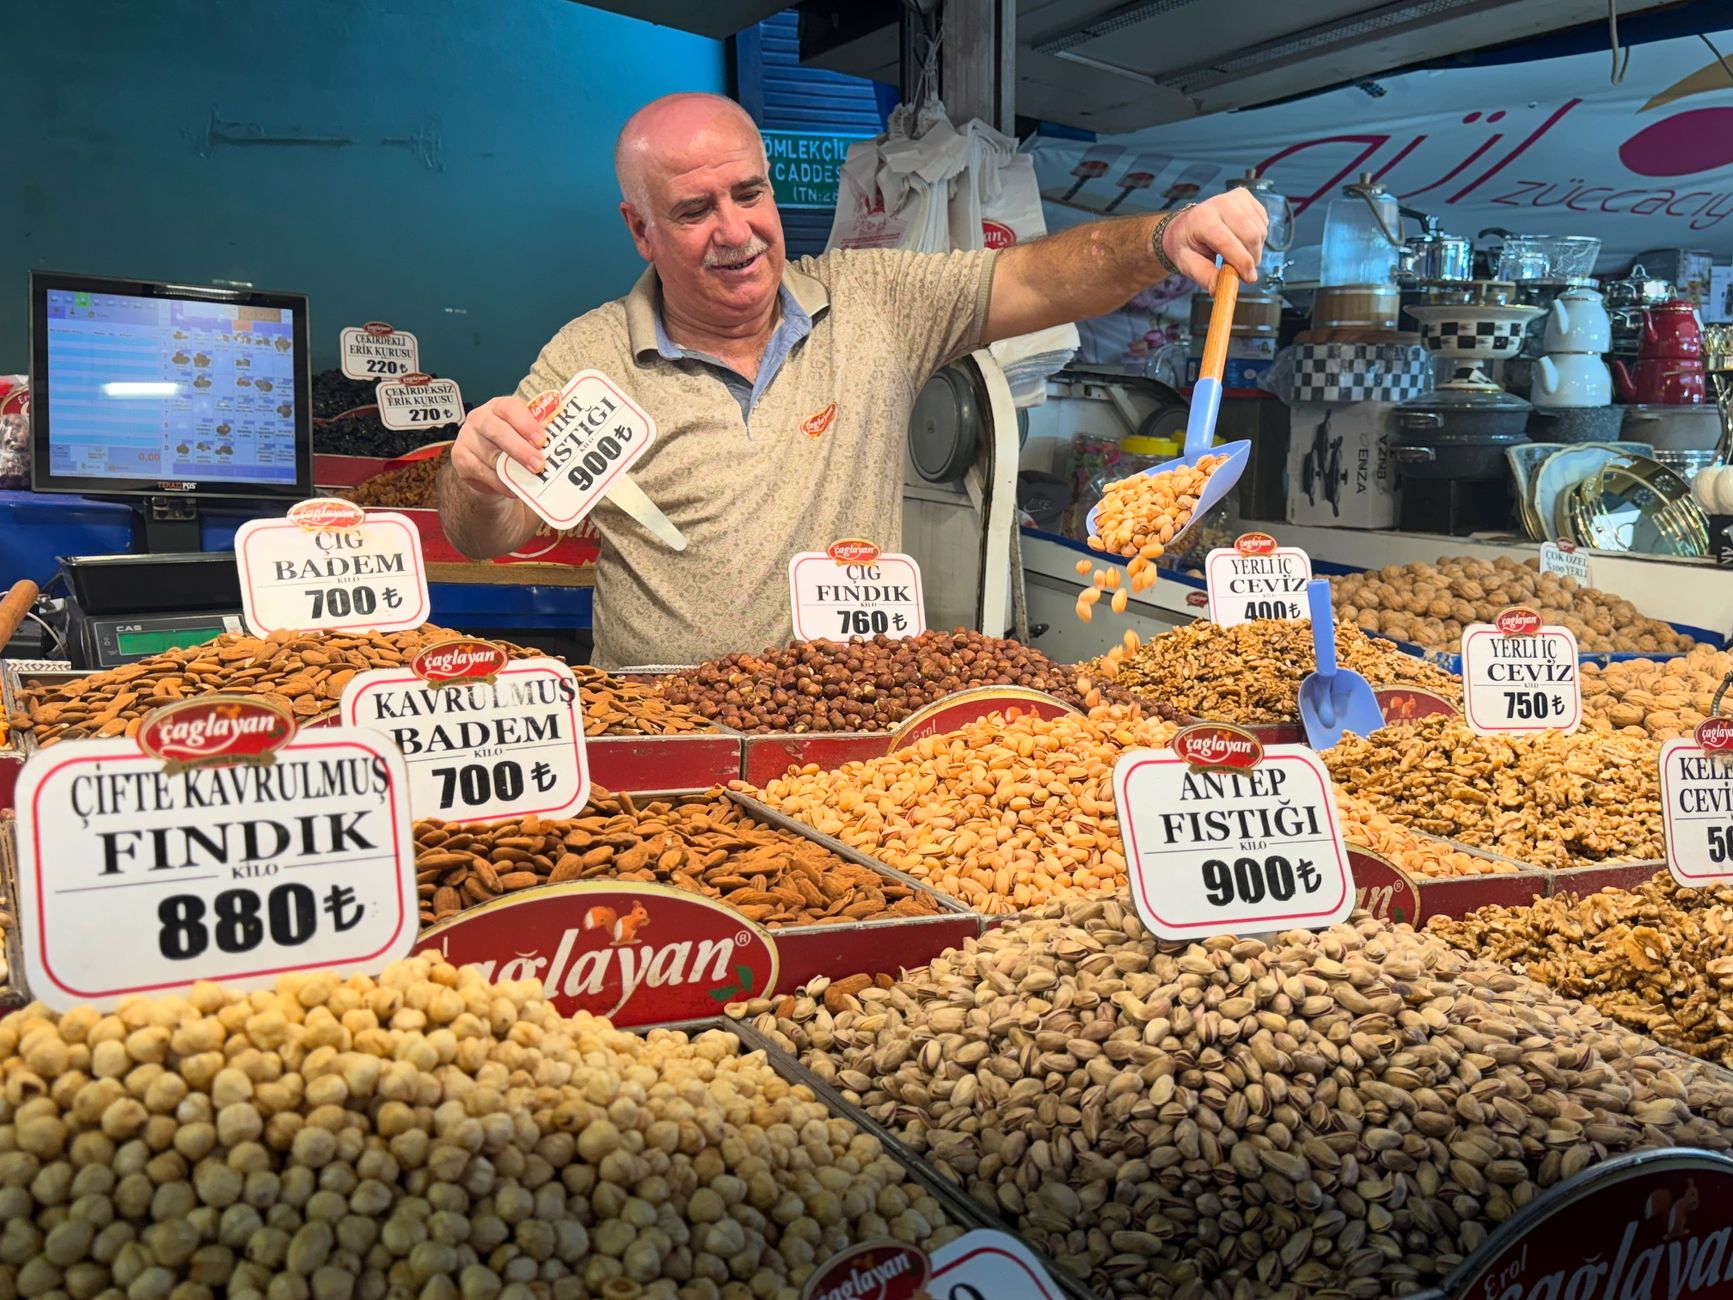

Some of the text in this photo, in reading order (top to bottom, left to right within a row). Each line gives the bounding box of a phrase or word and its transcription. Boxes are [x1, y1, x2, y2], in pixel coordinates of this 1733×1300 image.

[350, 344, 413, 359] ERİK KURUSU
[414, 394, 453, 405] KURUSU
[272, 552, 406, 581] BADEM
[816, 585, 911, 602] FINDIK
[1229, 574, 1308, 594] CEVİZ
[1542, 634, 1557, 664] İÇ
[1487, 659, 1574, 682] CEVİZ
[373, 677, 577, 720] KAVRULMUŞ
[390, 713, 562, 756] BADEM
[70, 756, 390, 829] ÇİFTE KAVRULMUŞ
[1179, 768, 1287, 801] ANTEP
[1159, 800, 1322, 844] FISTIĞI
[95, 810, 378, 876] FINDIK
